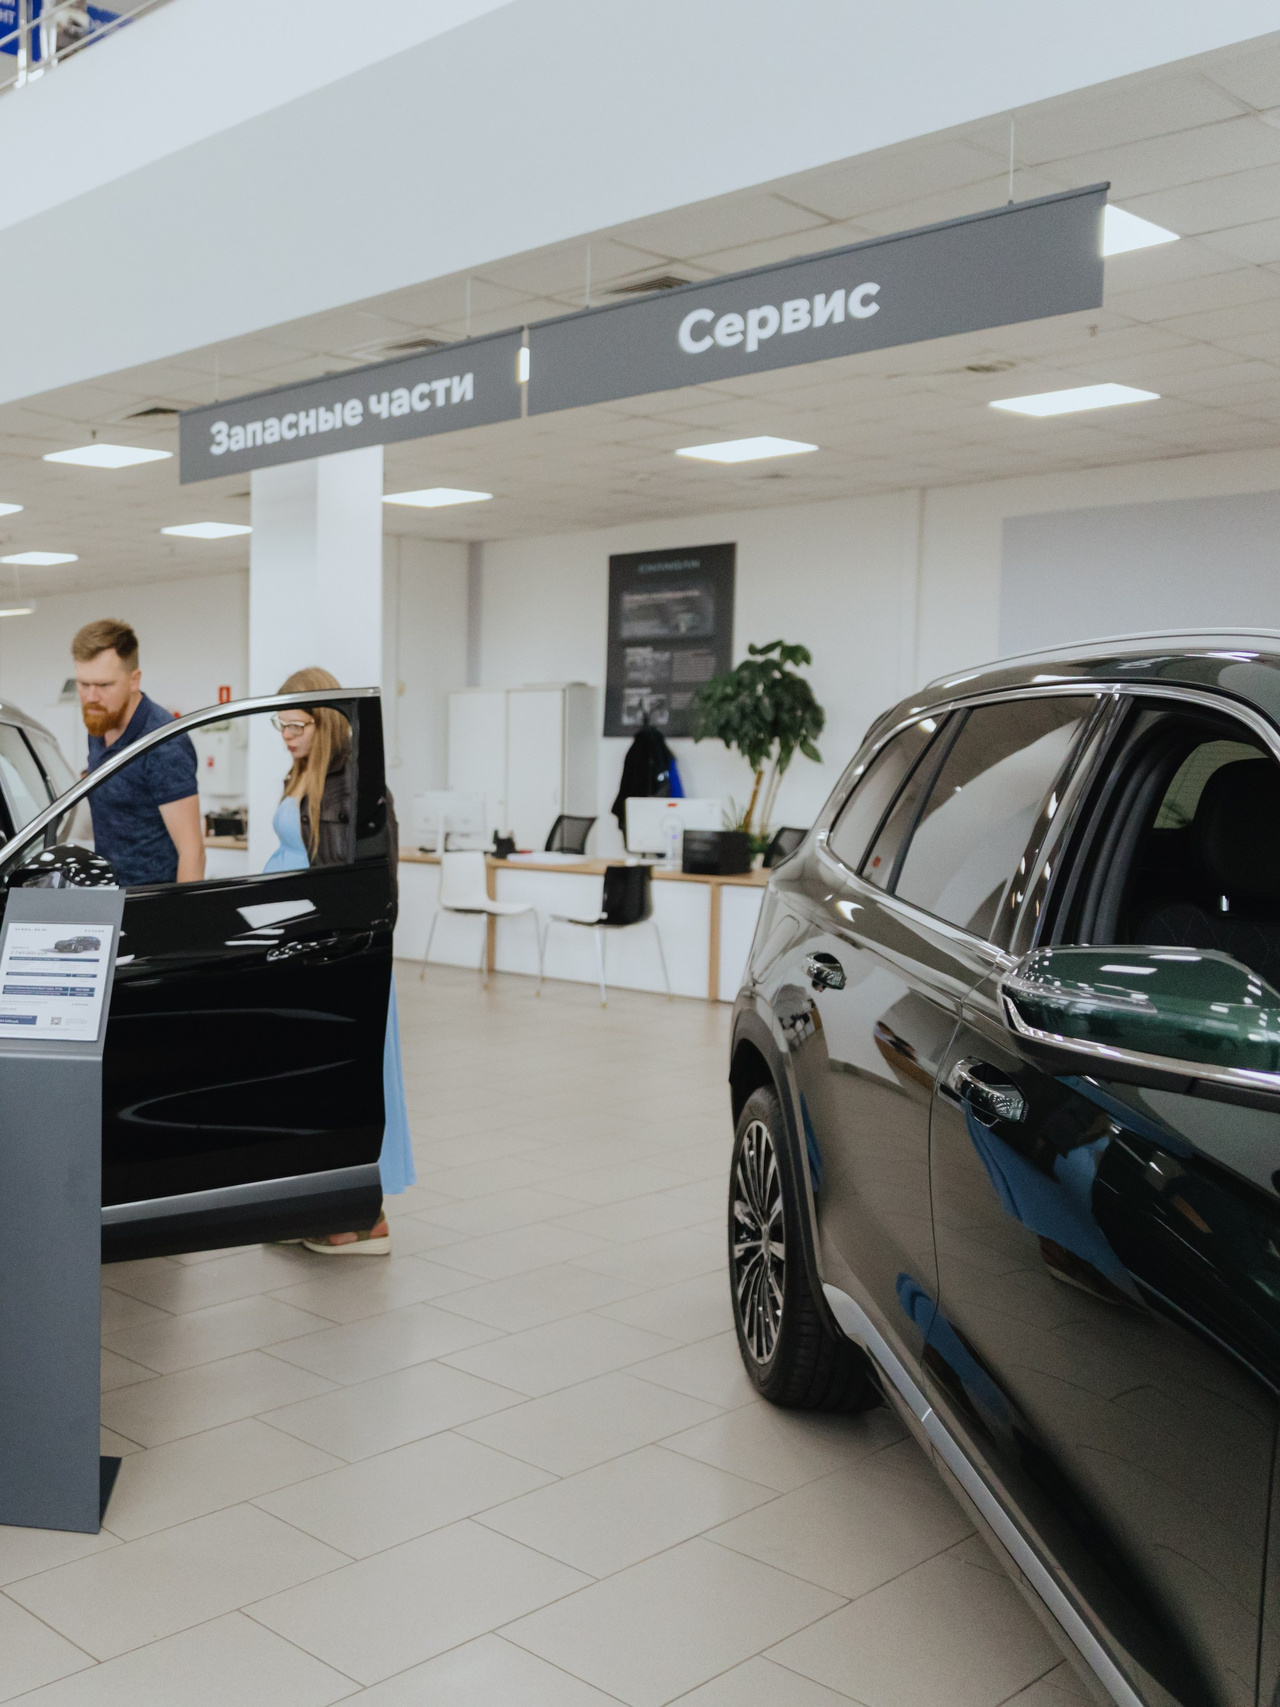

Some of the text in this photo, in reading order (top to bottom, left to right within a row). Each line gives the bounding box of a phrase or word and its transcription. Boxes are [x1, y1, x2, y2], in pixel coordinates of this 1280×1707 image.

[678, 281, 881, 354] Сервис
[209, 372, 474, 455] Запасные части
